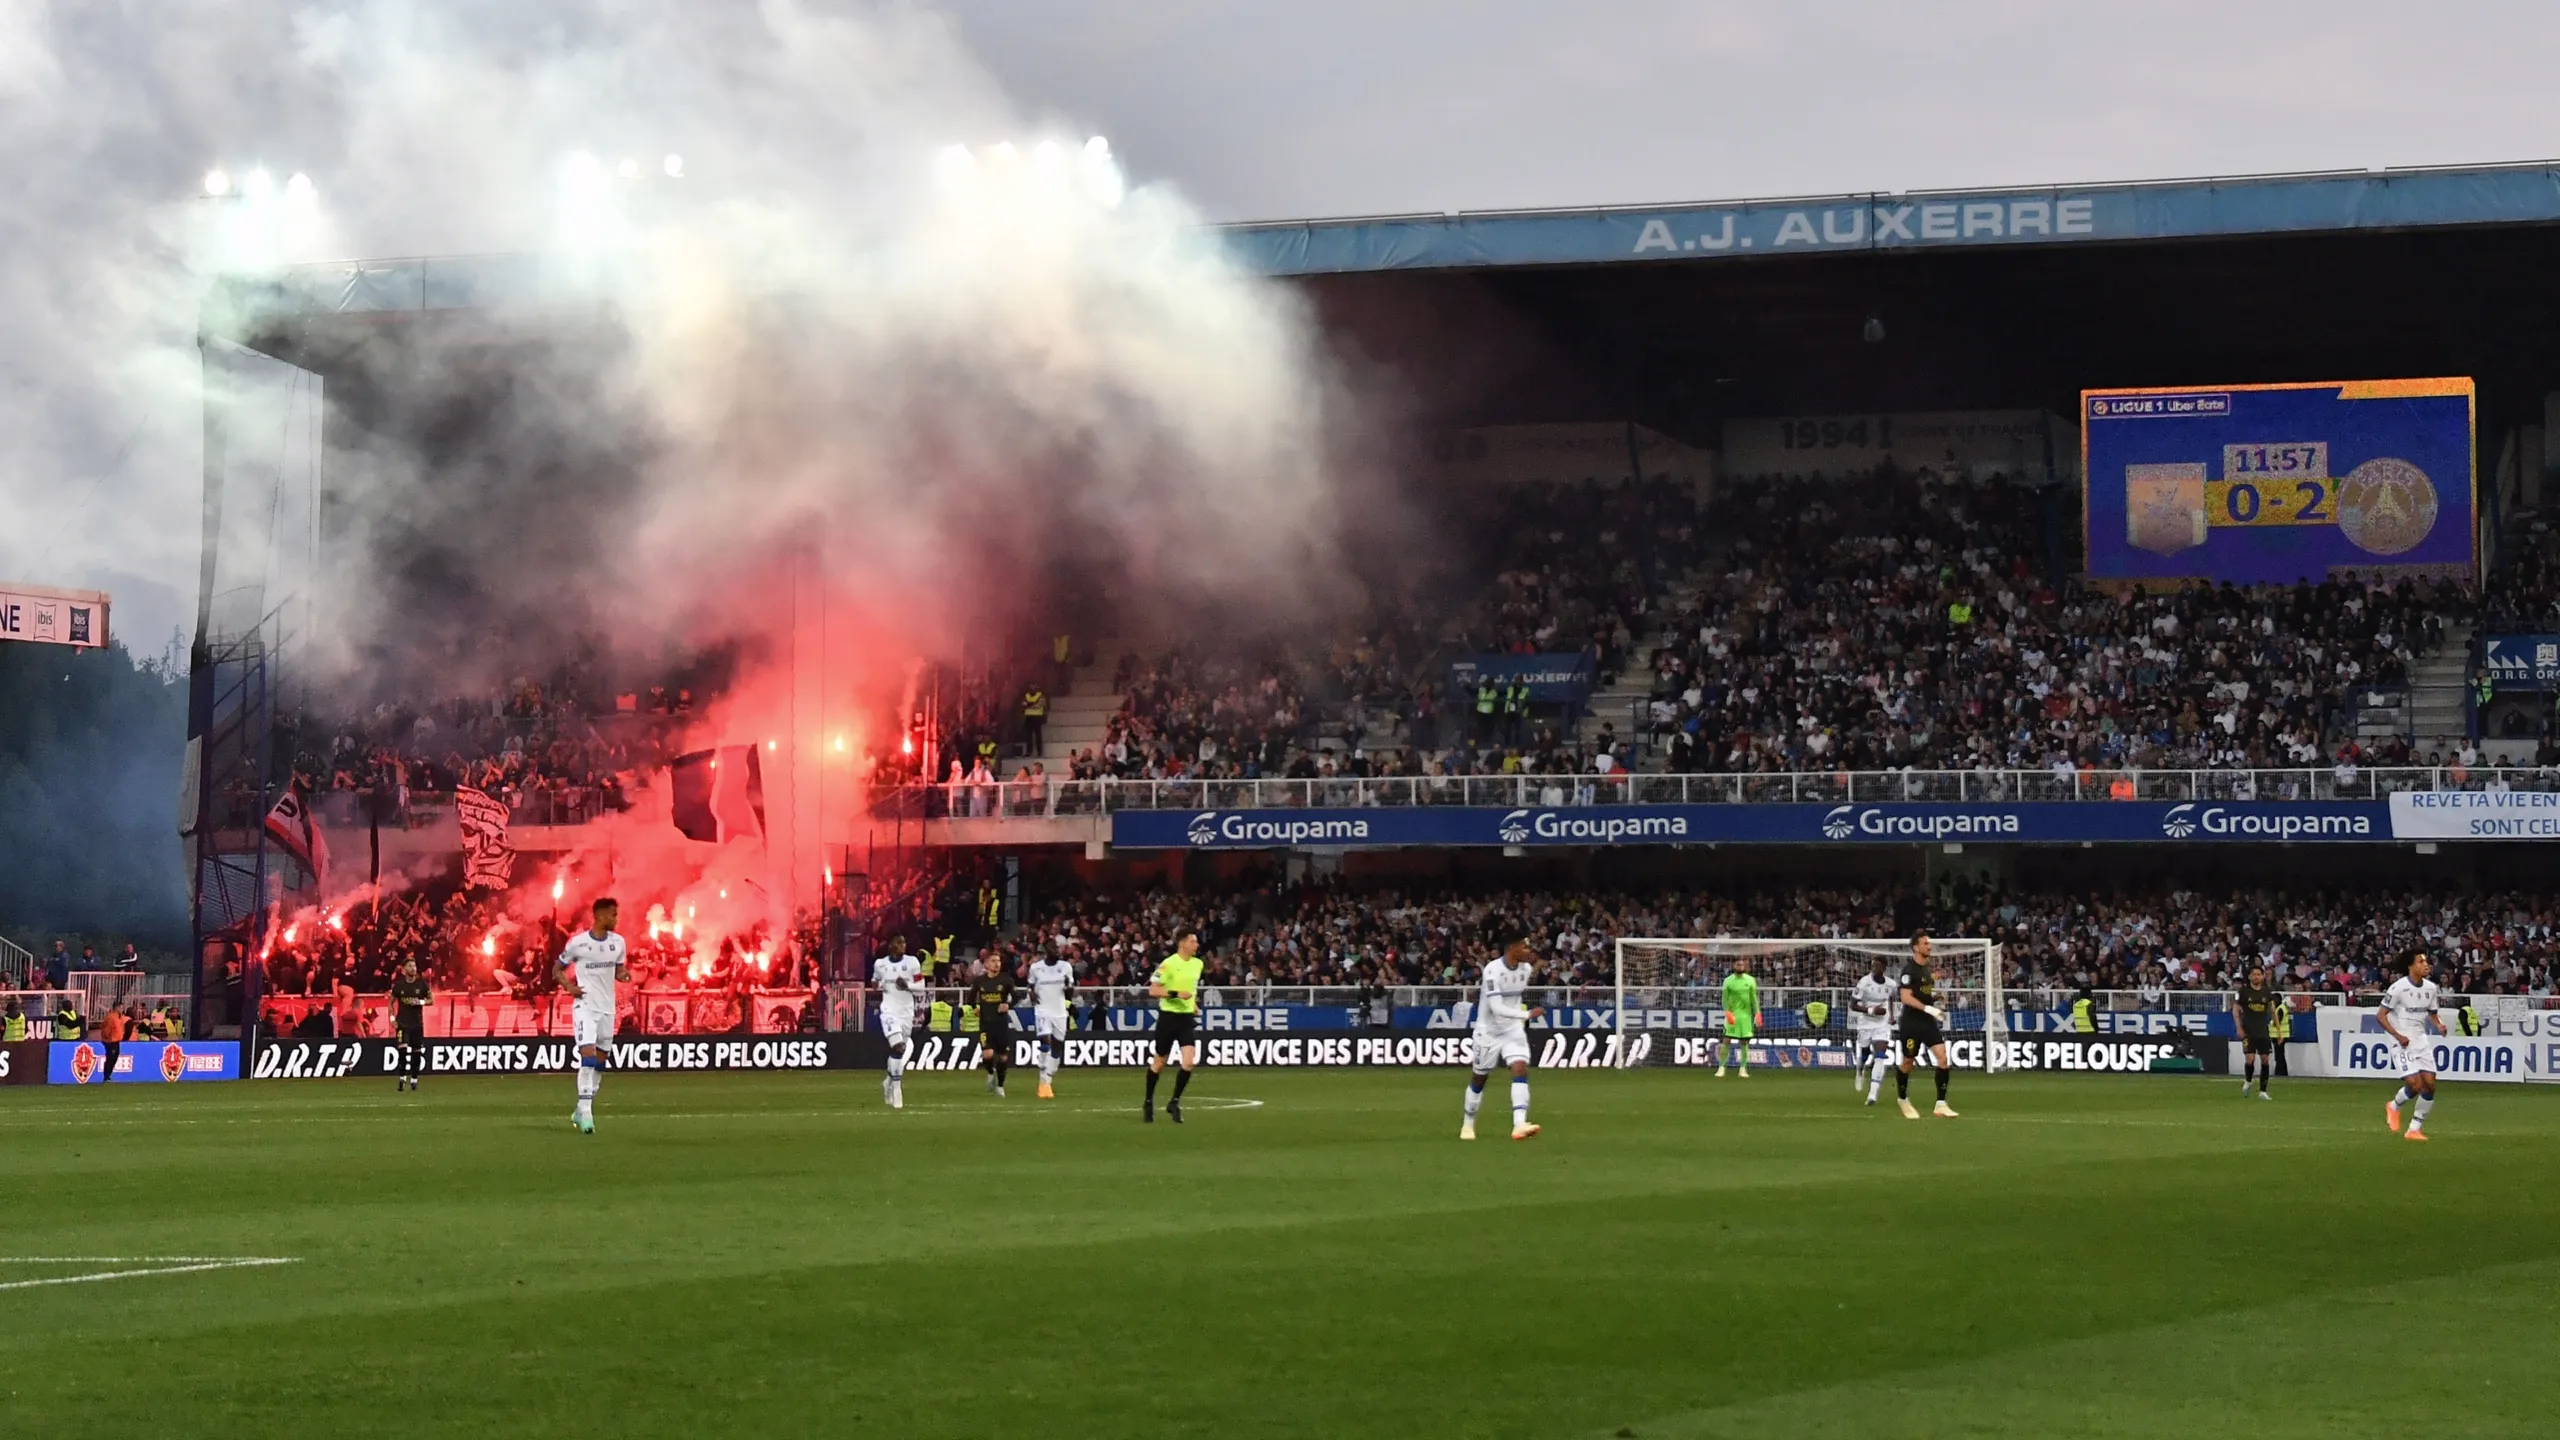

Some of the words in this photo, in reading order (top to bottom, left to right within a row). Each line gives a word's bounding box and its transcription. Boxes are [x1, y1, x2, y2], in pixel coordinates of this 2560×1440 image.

[1633, 215, 1753, 253] A.J.
[1774, 200, 2093, 246] AUXERRE
[2111, 401, 2153, 413] LIGUE
[2167, 400, 2195, 412] Uber
[2197, 398, 2225, 411] Eats
[2235, 447, 2317, 473] 11:57
[2226, 484, 2260, 522] 0
[2296, 481, 2327, 520] 2
[38, 611, 53, 625] ibis
[2413, 794, 2461, 808] REVE
[2466, 794, 2489, 808] TA
[2495, 793, 2526, 807] VIE
[2532, 793, 2557, 807] EN
[1222, 814, 1369, 844] Groupama
[1536, 813, 1688, 843] Groupama
[1860, 810, 2019, 840] Groupama
[2202, 808, 2370, 837] Groupama
[2471, 819, 2524, 835] SONT
[1085, 1009, 1288, 1031] URRE
[432, 1045, 528, 1070] EXPERTS
[533, 1045, 566, 1070] AU
[570, 1043, 664, 1069] SVICE
[667, 1043, 709, 1068] DES
[715, 1041, 827, 1067] PELOUSES
[1206, 1039, 1301, 1066] SERVICE
[1307, 1038, 1350, 1065] DES
[1357, 1038, 1474, 1065] PELOUSES
[1990, 1041, 2037, 1069] DES
[2350, 1042, 2513, 1074] ACOMIA
